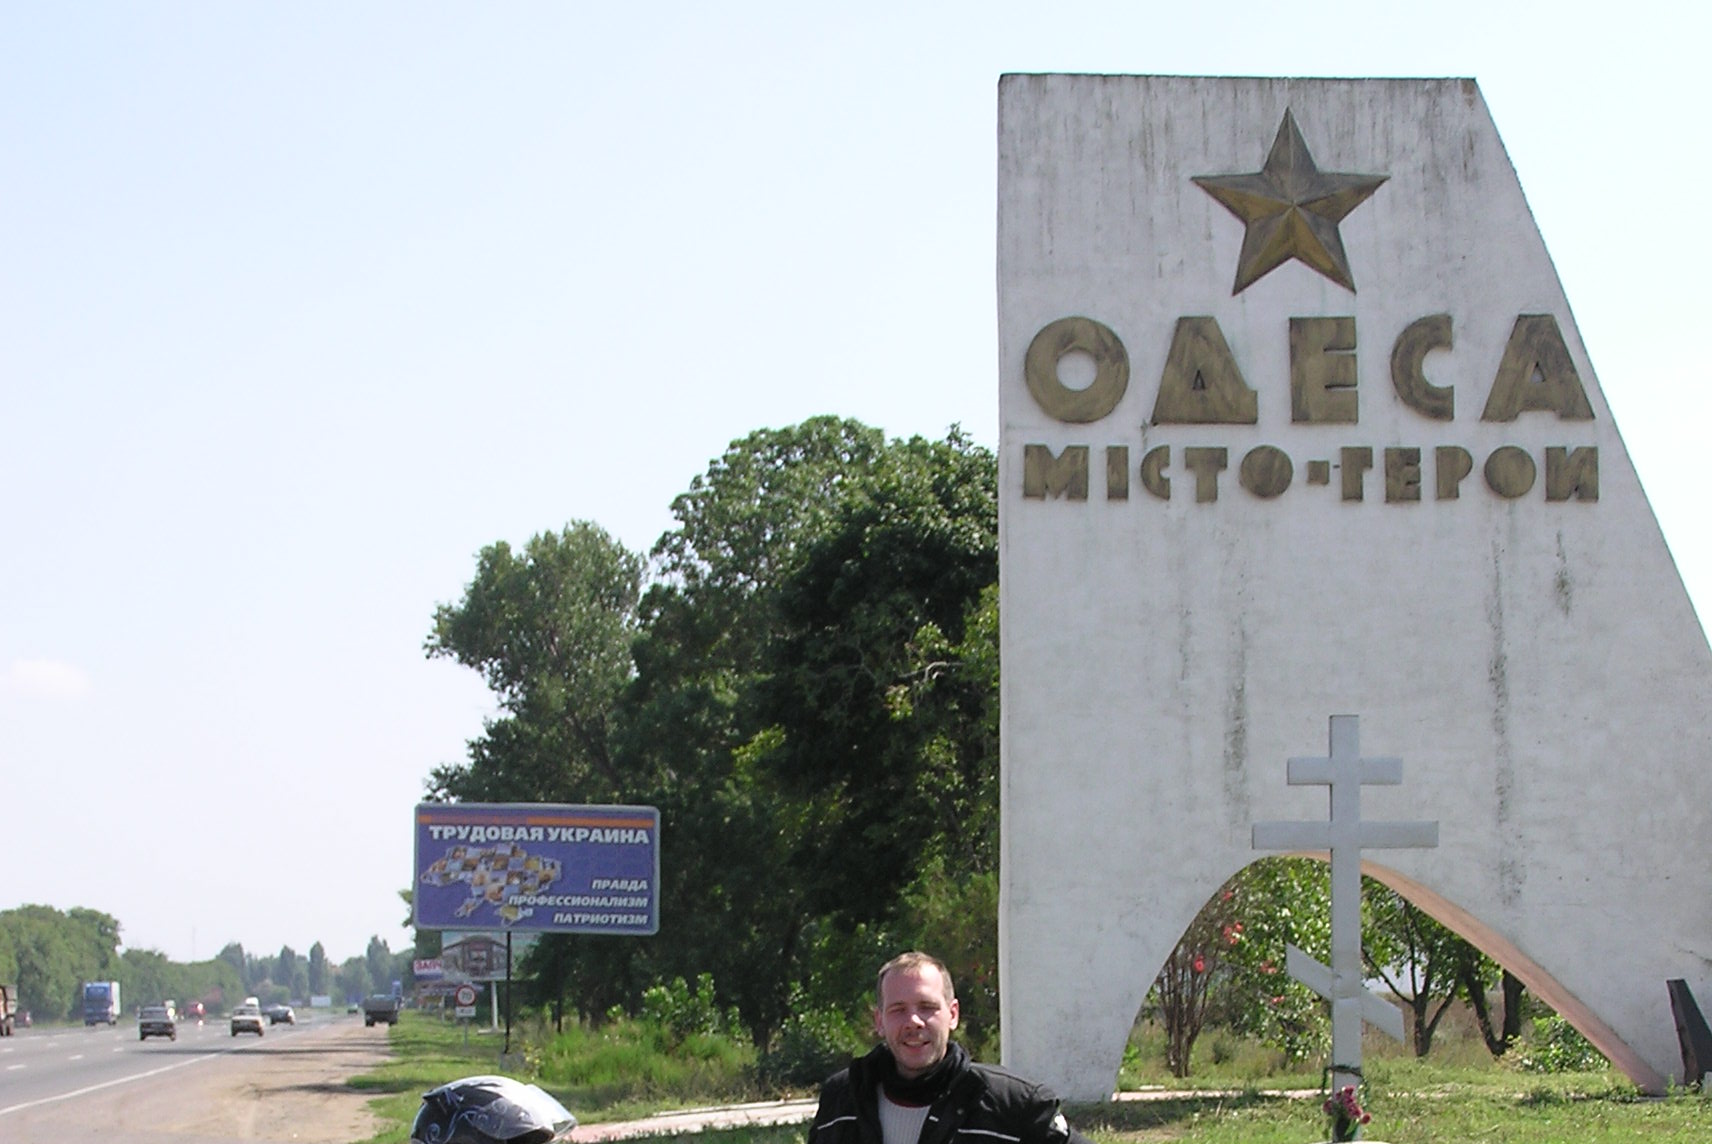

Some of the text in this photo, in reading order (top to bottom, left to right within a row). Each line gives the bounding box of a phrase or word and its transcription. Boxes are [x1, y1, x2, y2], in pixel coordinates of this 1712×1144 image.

[1023, 314, 1596, 424] ОДЕСА
[429, 825, 649, 844] ТРУДОВАЯ УКРАИНА
[592, 879, 648, 892] ПРАВДА
[508, 895, 648, 908] ПРОФЕССИОНАЛИЗМ
[553, 912, 648, 925] ПАТРИОТИЗМ
